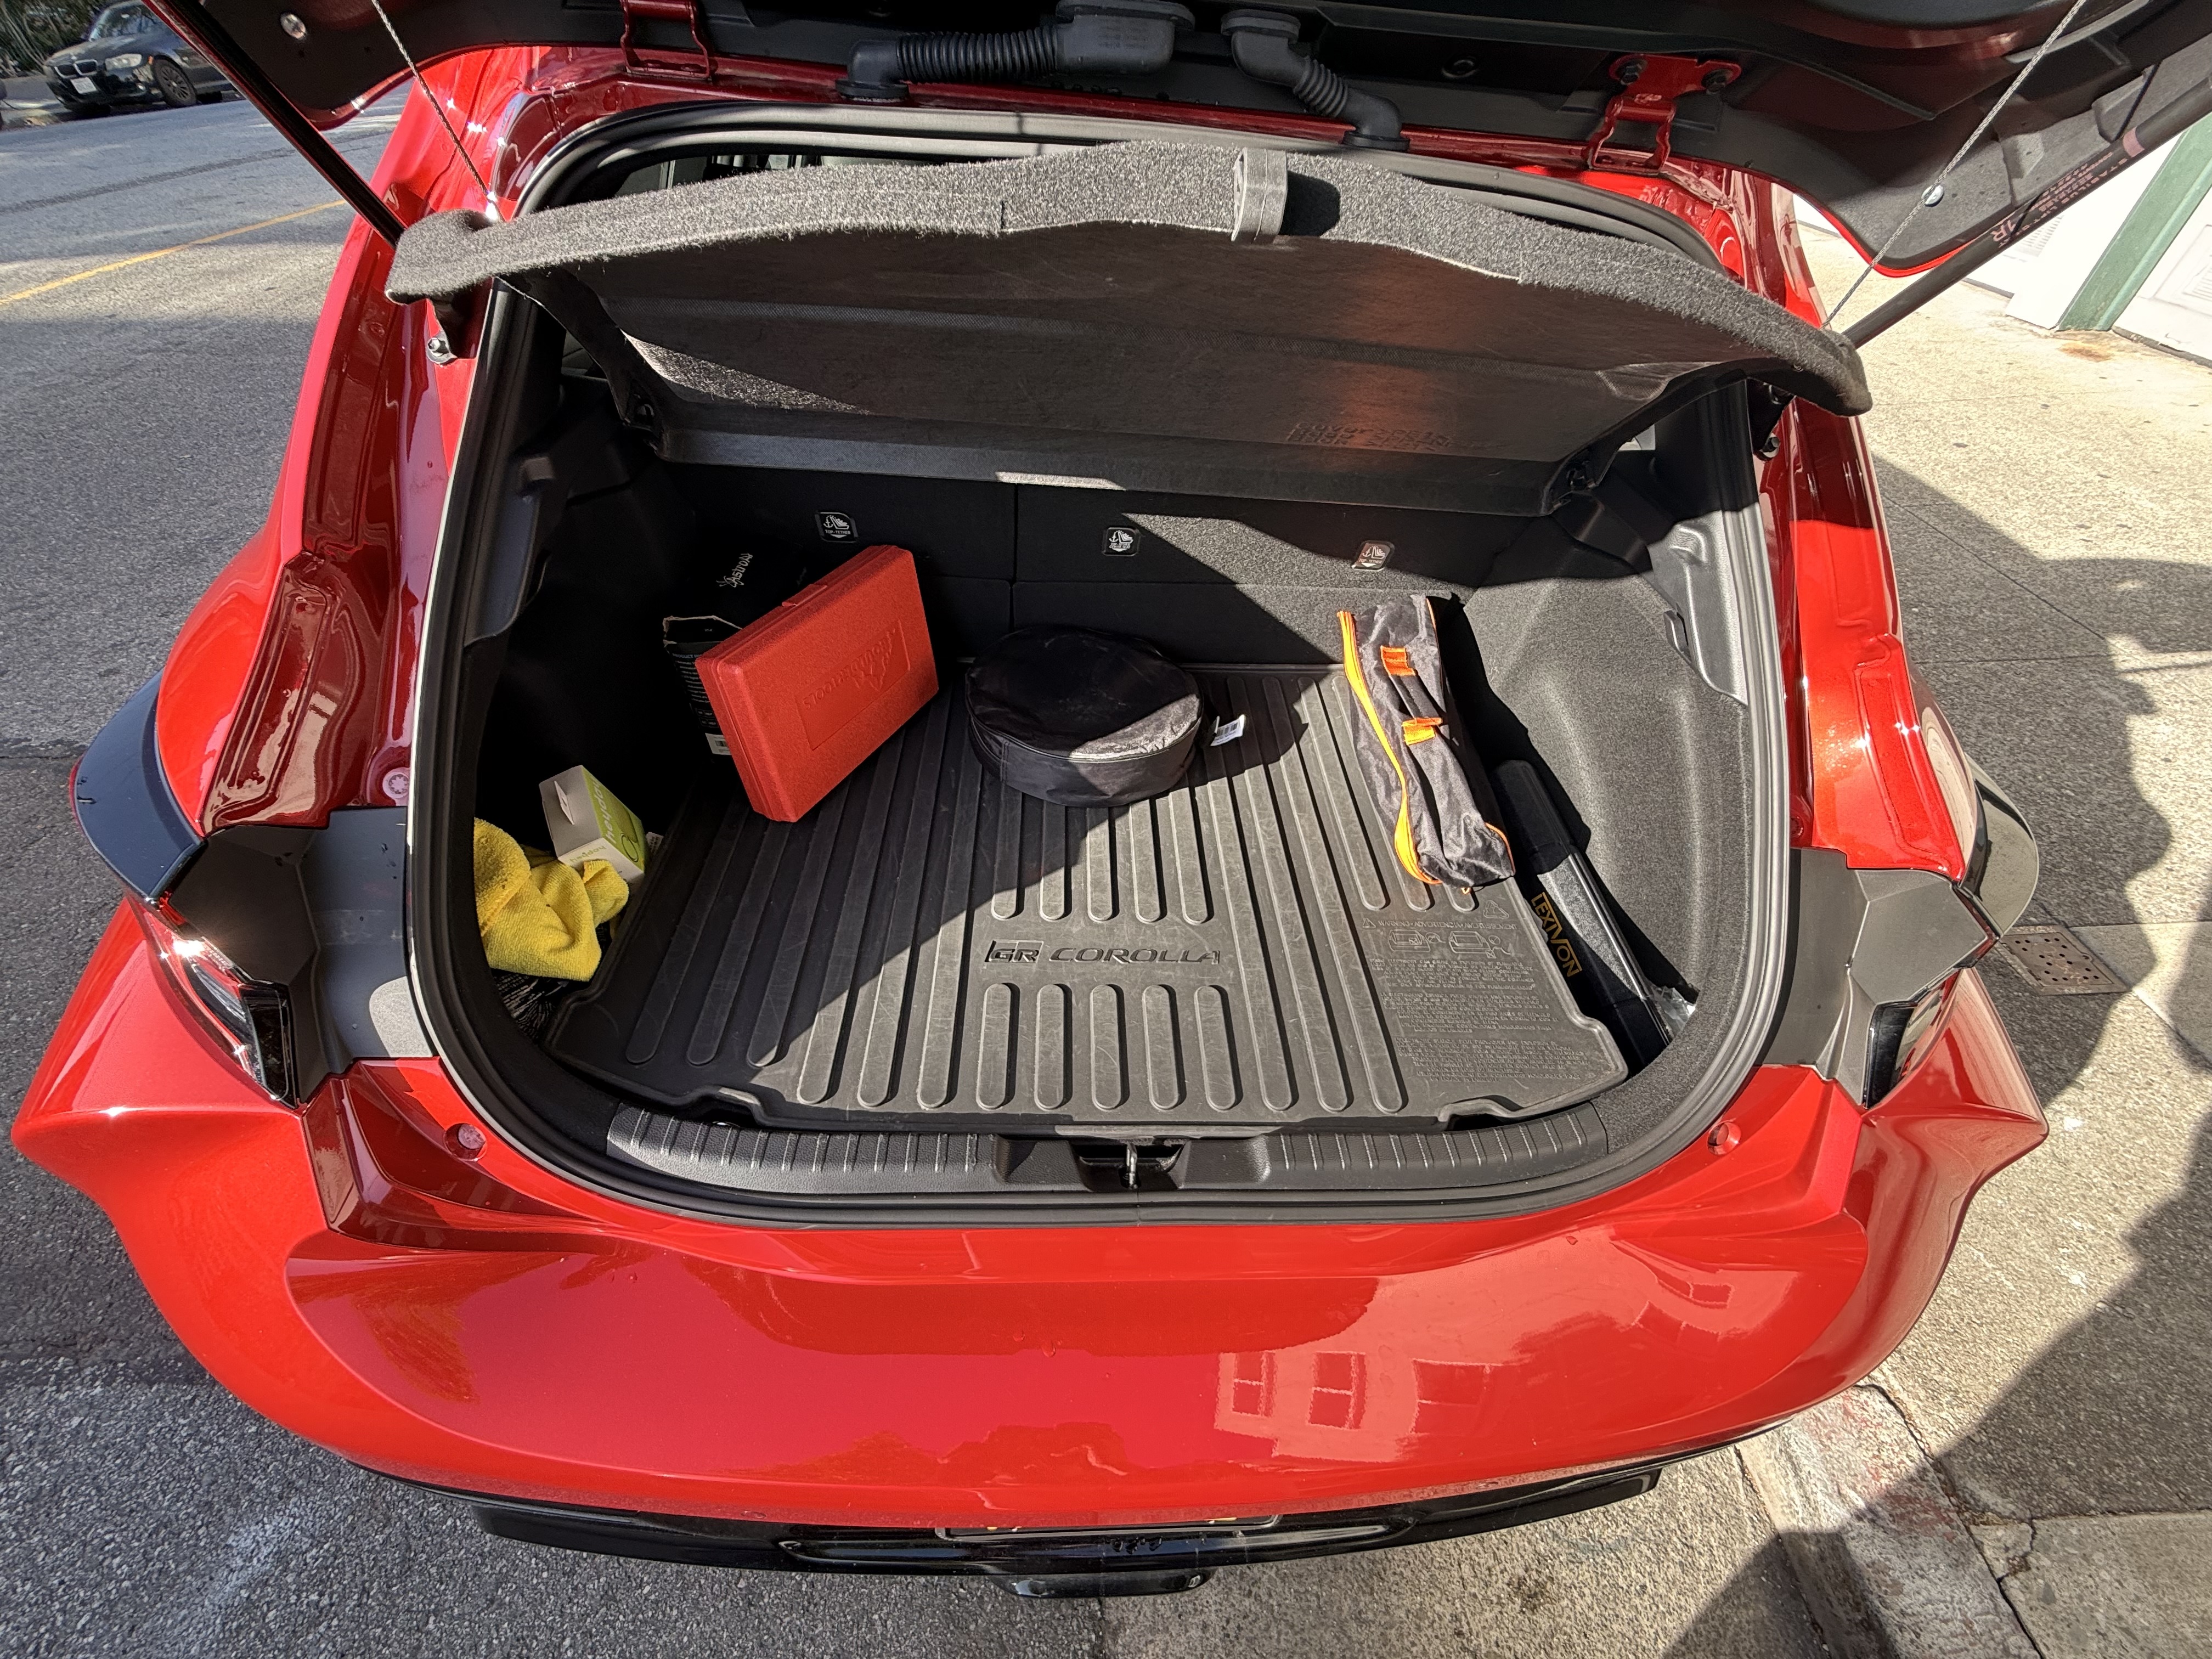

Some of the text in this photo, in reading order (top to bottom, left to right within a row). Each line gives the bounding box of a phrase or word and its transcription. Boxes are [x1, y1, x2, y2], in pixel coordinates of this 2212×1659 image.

[1990, 218, 2016, 242] 1R
[569, 845, 606, 864] heyday
[1531, 891, 1582, 977] LEXIVON
[988, 947, 1221, 964] GR COROLLA
